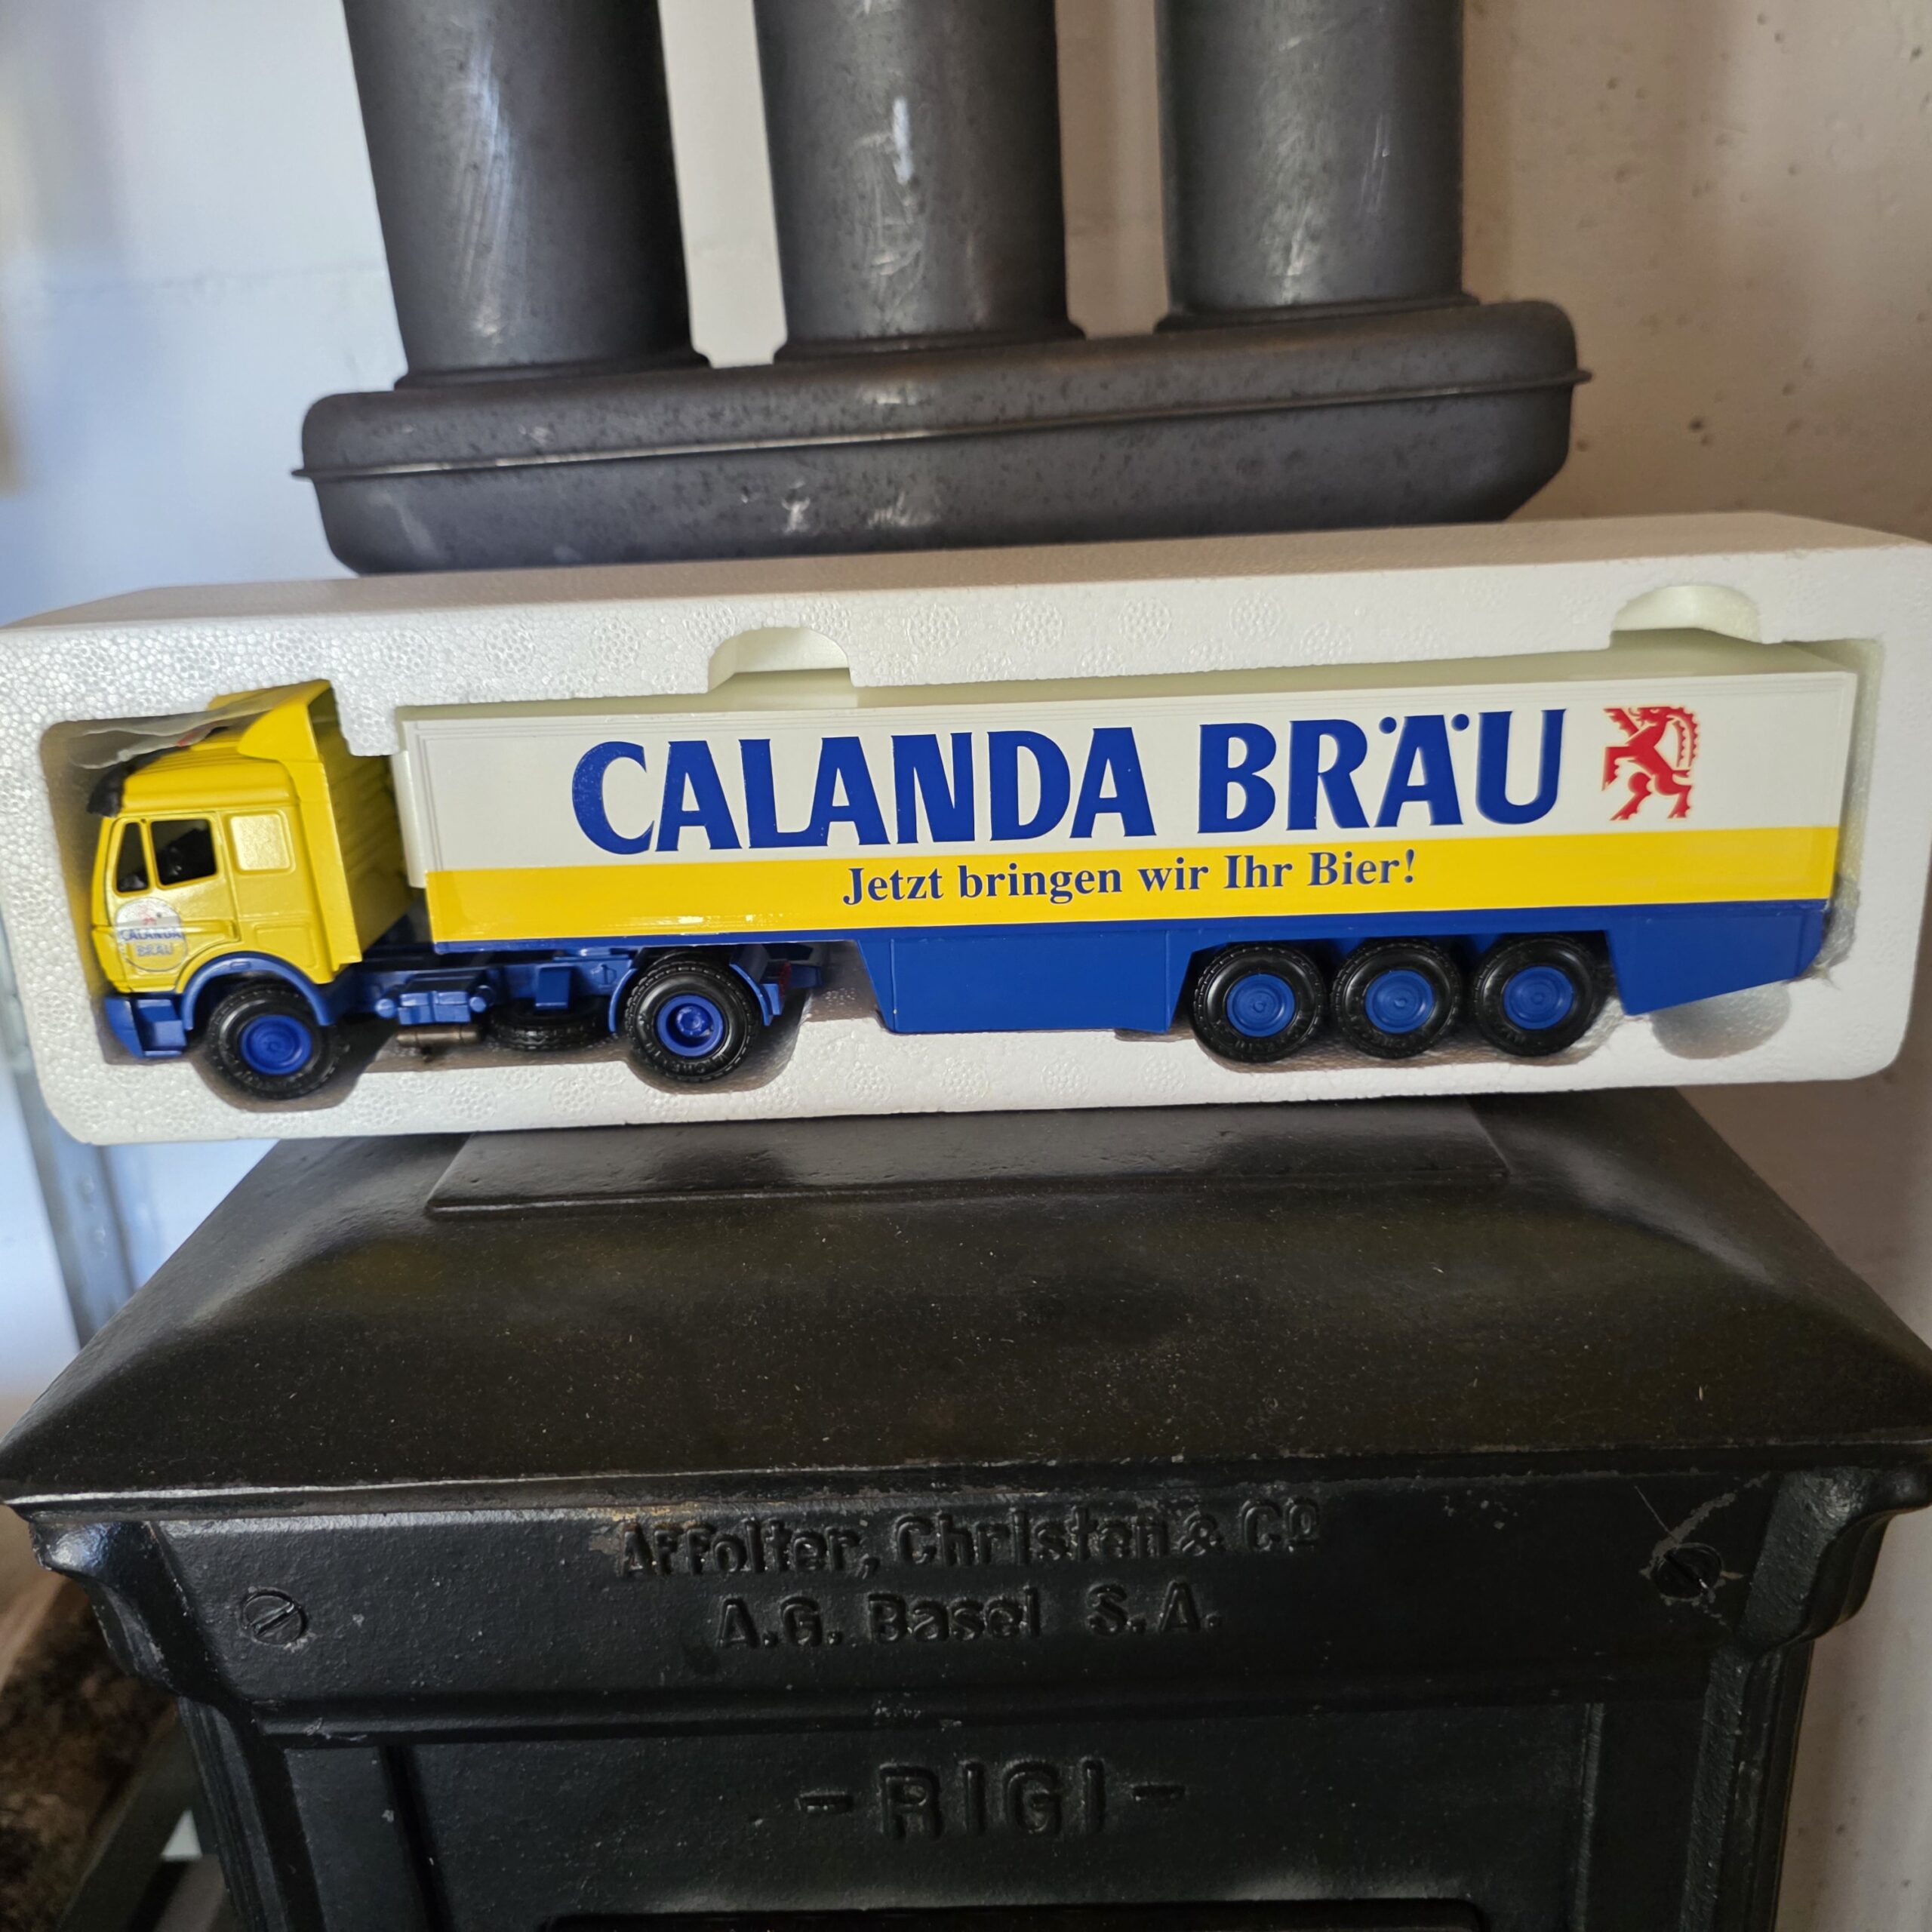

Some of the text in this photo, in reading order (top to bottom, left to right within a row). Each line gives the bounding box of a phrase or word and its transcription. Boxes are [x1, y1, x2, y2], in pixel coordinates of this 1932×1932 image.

[571, 709, 1567, 854] CALANDA BRÄU
[843, 849, 1416, 906] Jetzt bringen wir Ihr Bier!
[1177, 1509, 1225, 1557] &
[716, 1579, 1223, 1648] A.G. Basel S.A.
